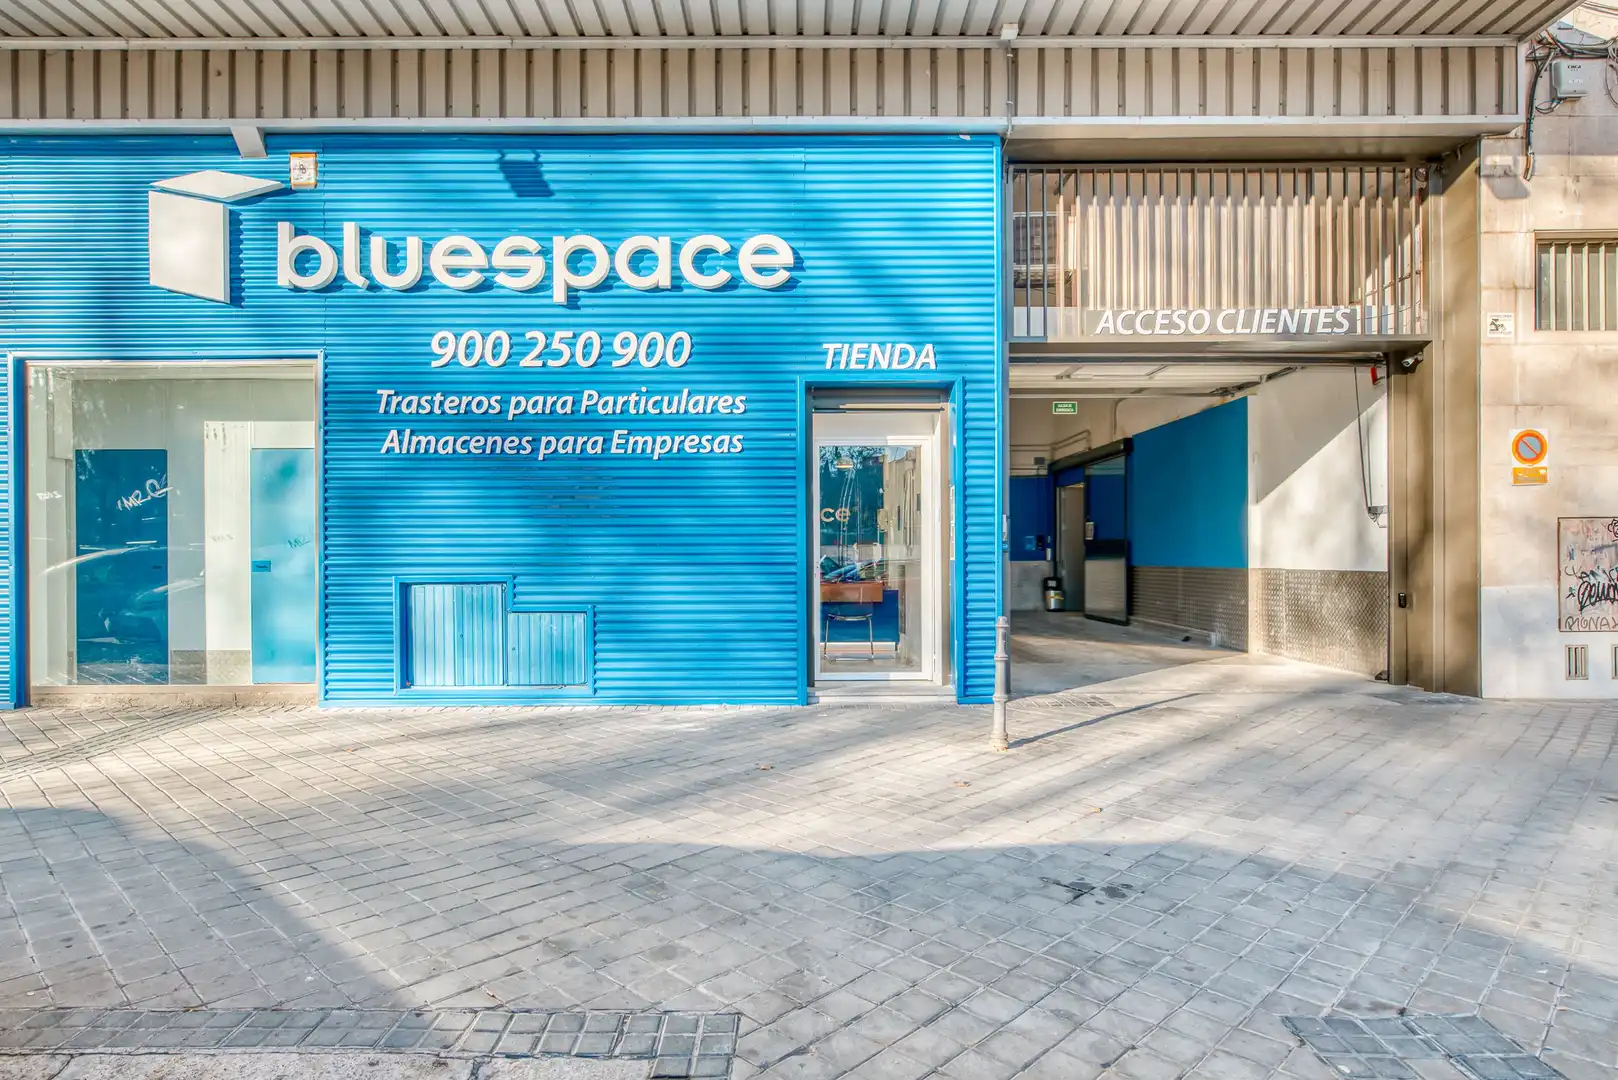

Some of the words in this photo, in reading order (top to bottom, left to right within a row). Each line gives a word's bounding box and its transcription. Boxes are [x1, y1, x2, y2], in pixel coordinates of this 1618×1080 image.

[277, 221, 794, 304] bluespace
[1095, 309, 1211, 335] ACCESO
[1216, 308, 1351, 335] CLIENTES
[430, 330, 510, 368] 900
[519, 330, 601, 368] 250
[611, 330, 691, 368] 900
[822, 343, 937, 370] TIENDA
[376, 389, 501, 414] Trasteros
[507, 395, 574, 420] para
[580, 387, 747, 415] Particulares
[381, 429, 533, 455] Almacenes
[538, 435, 604, 460] para
[610, 429, 744, 459] Empresas
